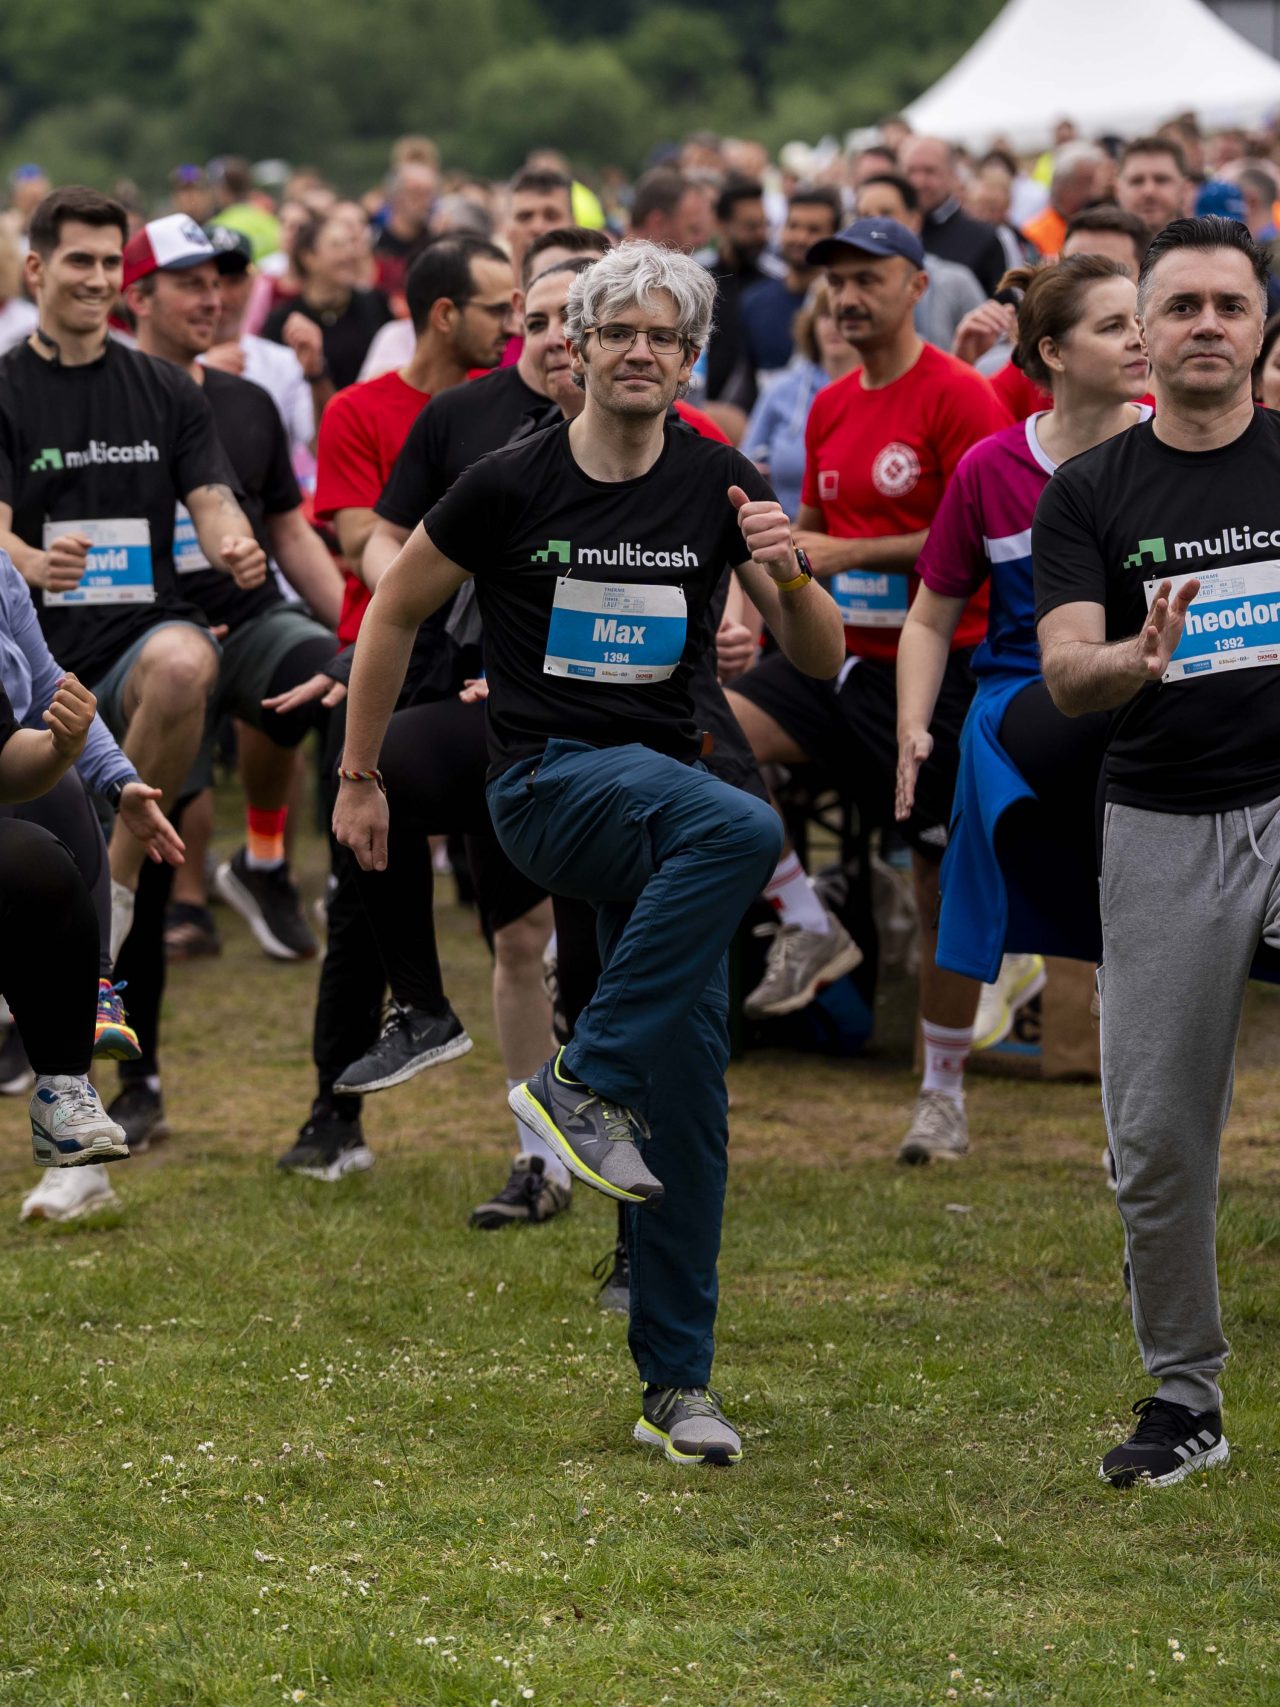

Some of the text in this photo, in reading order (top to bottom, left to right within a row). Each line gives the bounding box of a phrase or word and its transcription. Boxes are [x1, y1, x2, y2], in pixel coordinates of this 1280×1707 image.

[86, 548, 128, 571] avid
[577, 543, 699, 567] multicash
[1185, 601, 1280, 636] heodor
[592, 618, 647, 645] Max
[1214, 637, 1244, 651] 1392
[603, 652, 630, 664] 1394
